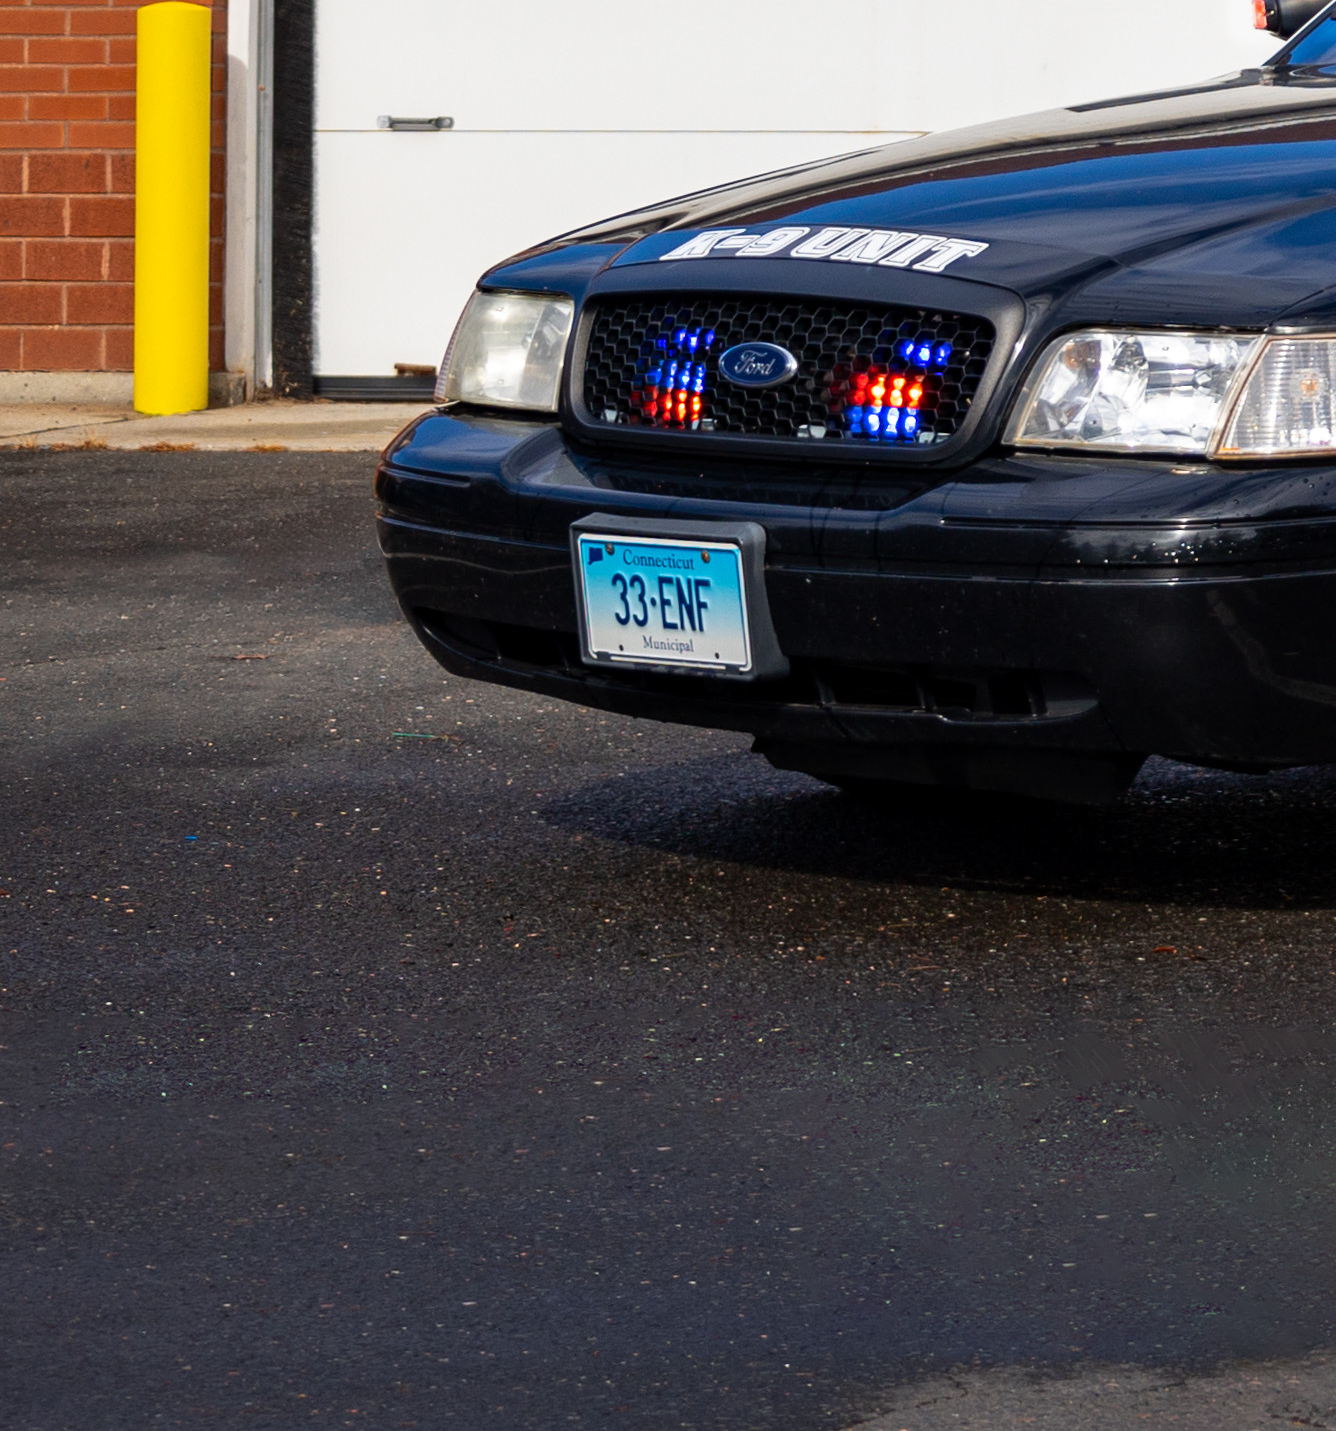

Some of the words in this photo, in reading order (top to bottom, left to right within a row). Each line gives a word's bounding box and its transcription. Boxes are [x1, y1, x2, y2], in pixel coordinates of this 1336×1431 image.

[659, 226, 812, 261] K-9
[790, 226, 990, 273] UNIT
[734, 350, 776, 375] Ford
[622, 549, 695, 570] Connecticut
[642, 635, 695, 654] Municipal
